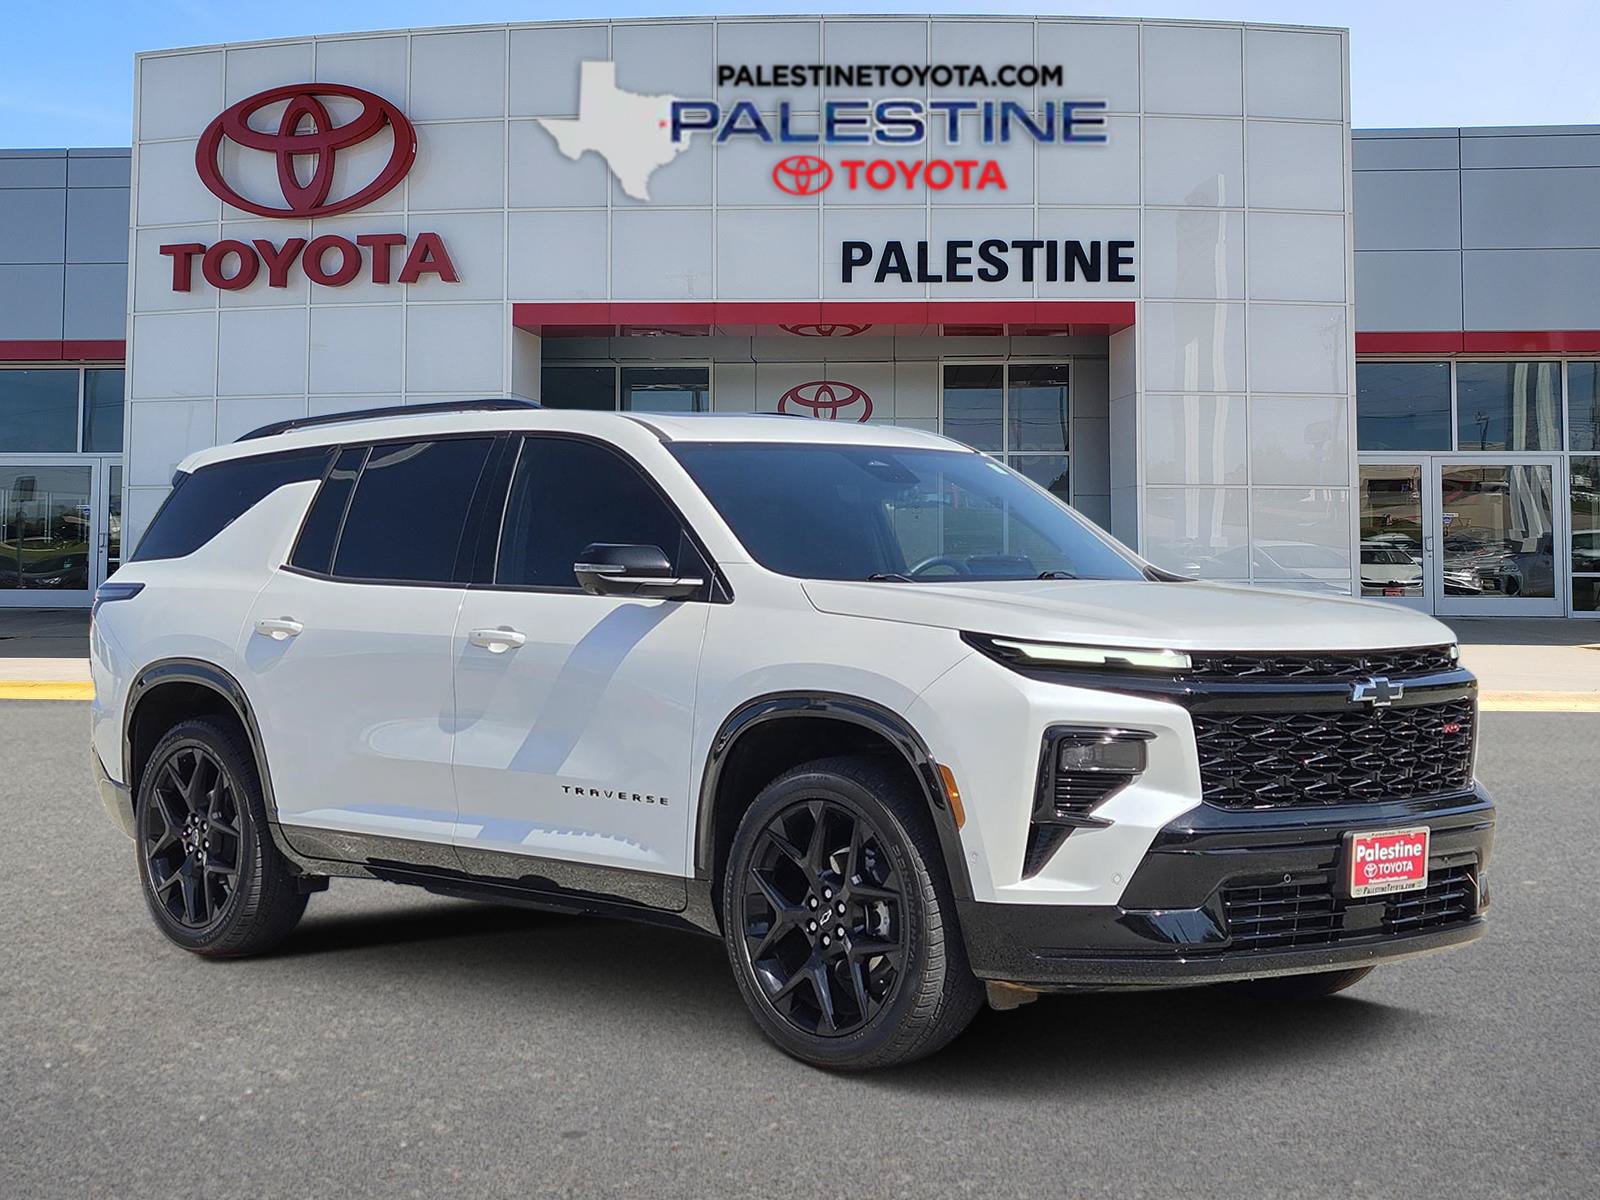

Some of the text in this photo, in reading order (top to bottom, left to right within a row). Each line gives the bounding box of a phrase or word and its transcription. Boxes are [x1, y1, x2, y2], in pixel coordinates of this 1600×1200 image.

[159, 232, 460, 292] TOYOTA
[841, 240, 1136, 283] PALESTINE
[561, 785, 669, 806] TRAVERSE
[1356, 840, 1423, 863] Palestine
[1378, 860, 1414, 875] TOYOTA
